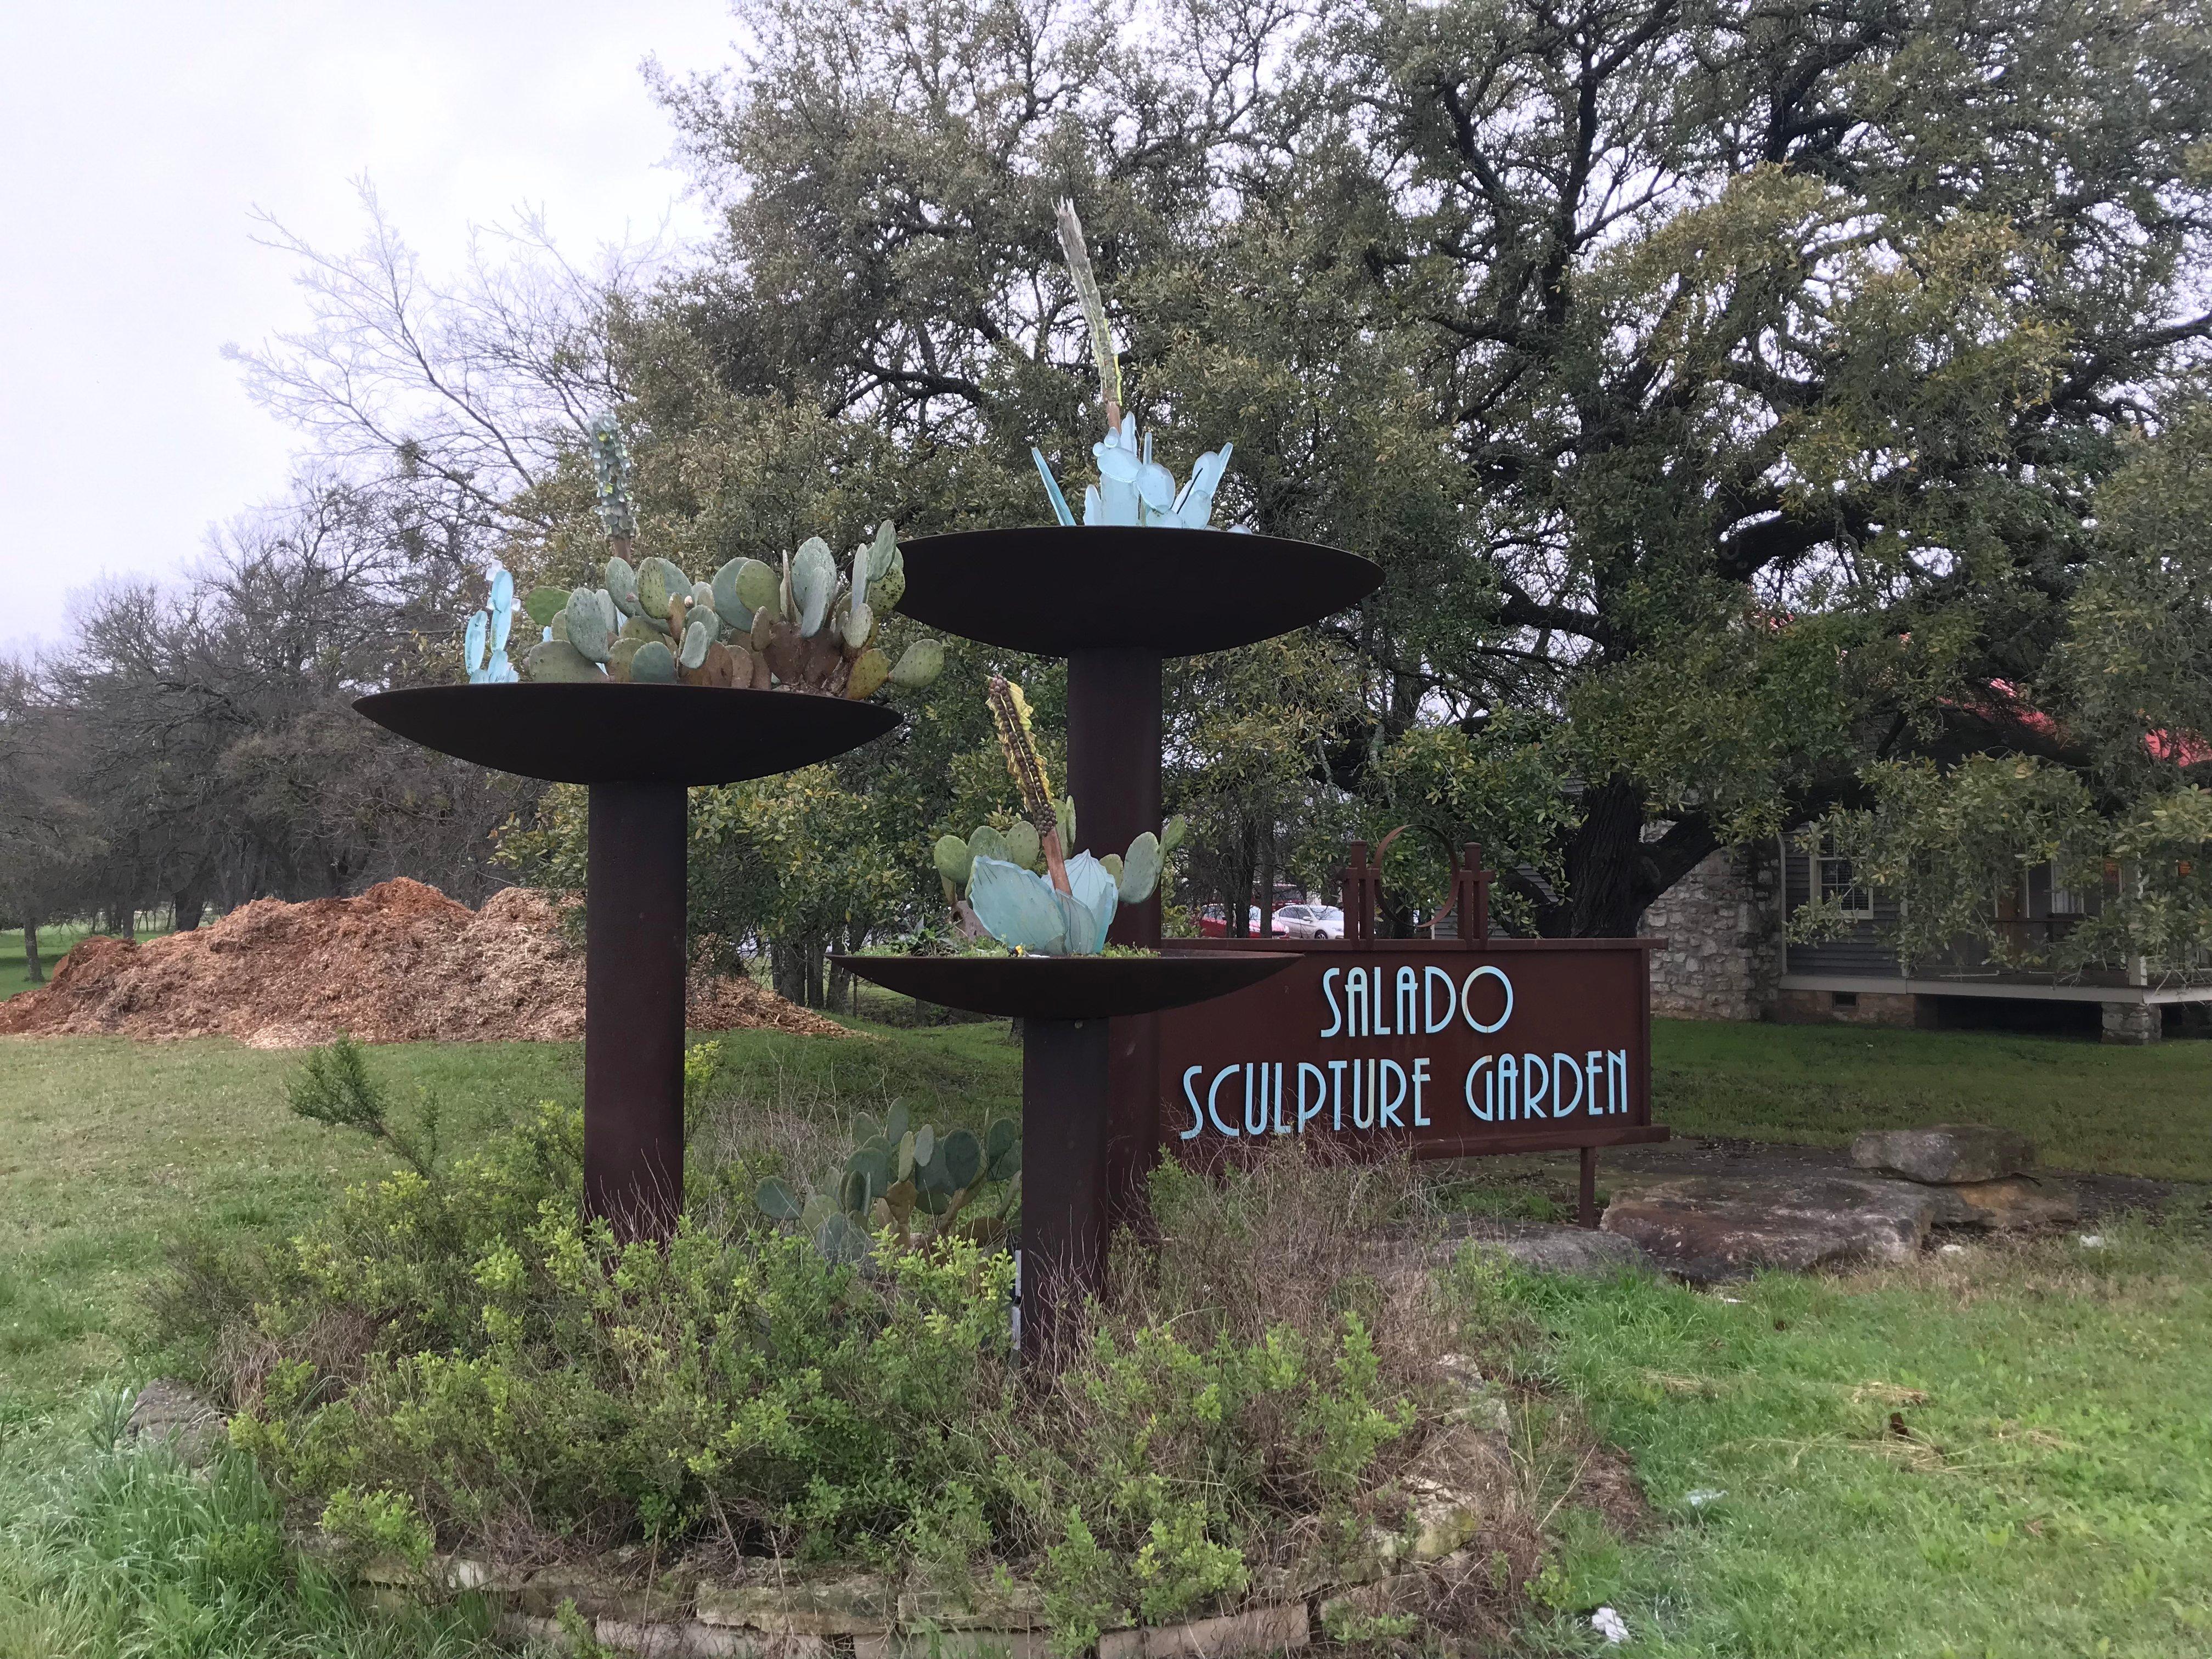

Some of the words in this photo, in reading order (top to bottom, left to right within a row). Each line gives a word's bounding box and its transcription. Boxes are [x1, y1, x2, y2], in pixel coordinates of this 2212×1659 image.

[1321, 966, 1514, 1037] SALADO
[1181, 1057, 1431, 1139] SCULPTURE
[1465, 1049, 1628, 1121] GARDEN
